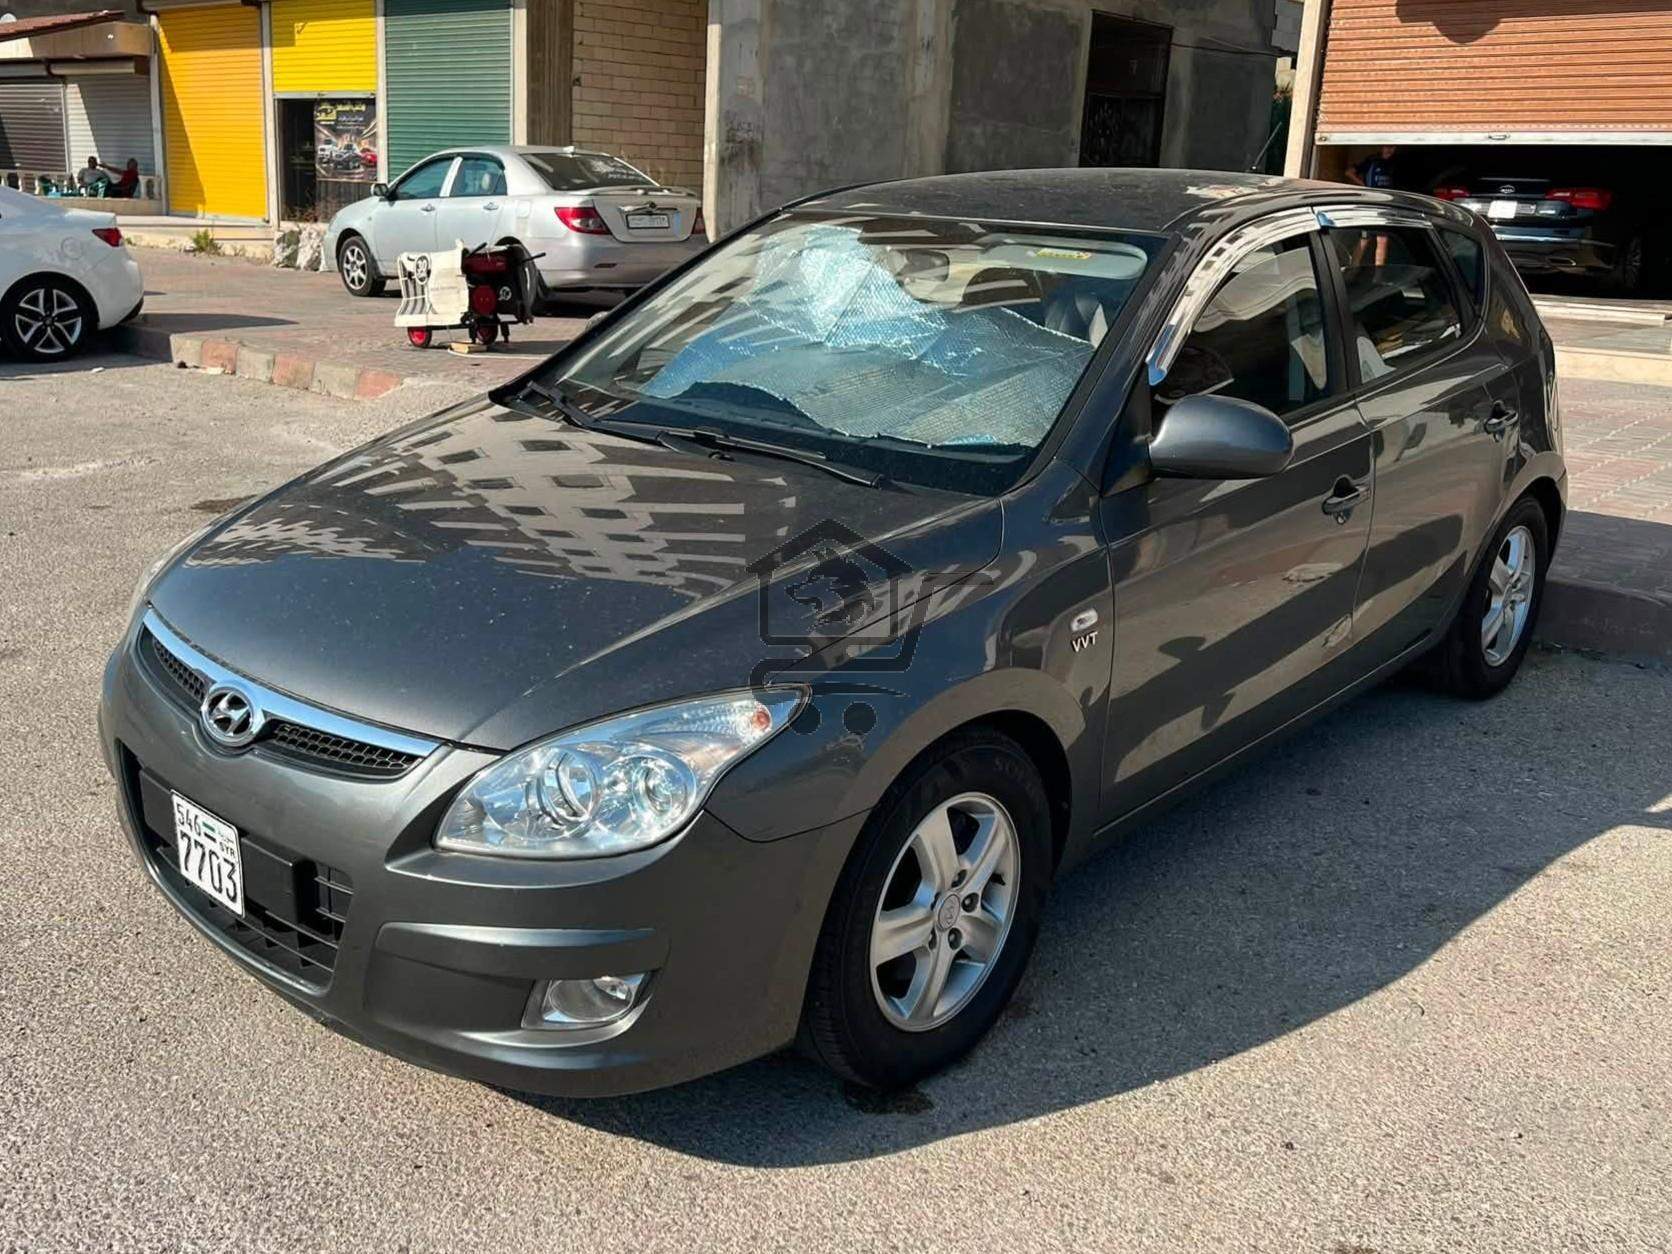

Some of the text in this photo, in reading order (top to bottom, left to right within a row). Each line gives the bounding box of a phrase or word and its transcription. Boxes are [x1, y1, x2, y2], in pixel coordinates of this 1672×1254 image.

[1072, 631, 1098, 652] VVT
[176, 803, 201, 836] 546
[180, 829, 238, 903] 7703
